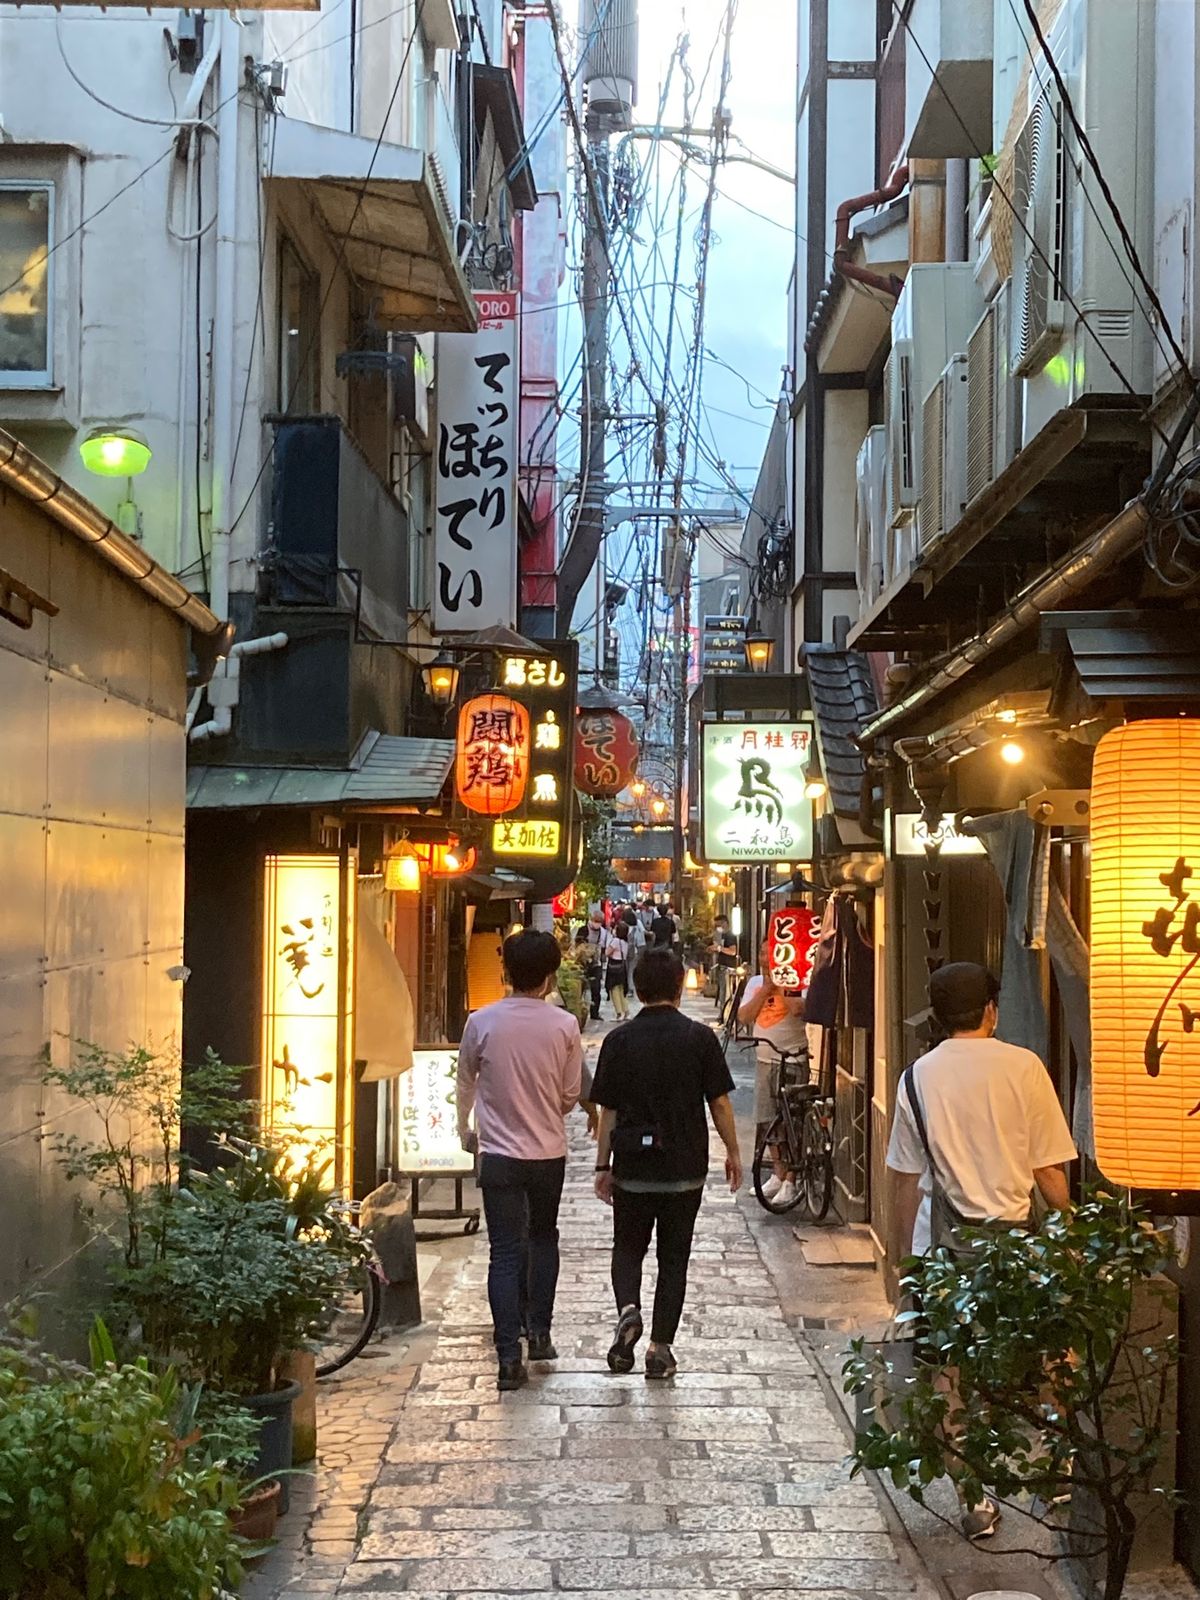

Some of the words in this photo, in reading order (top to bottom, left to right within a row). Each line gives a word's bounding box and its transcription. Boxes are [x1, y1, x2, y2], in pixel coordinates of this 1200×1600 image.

[475, 352, 511, 530] てっちり
[438, 422, 483, 612] ほてい
[577, 715, 620, 787] ほてい
[741, 730, 809, 751] 月桂冠
[724, 826, 794, 848] 二和鳥
[731, 847, 787, 856] NIWATORI
